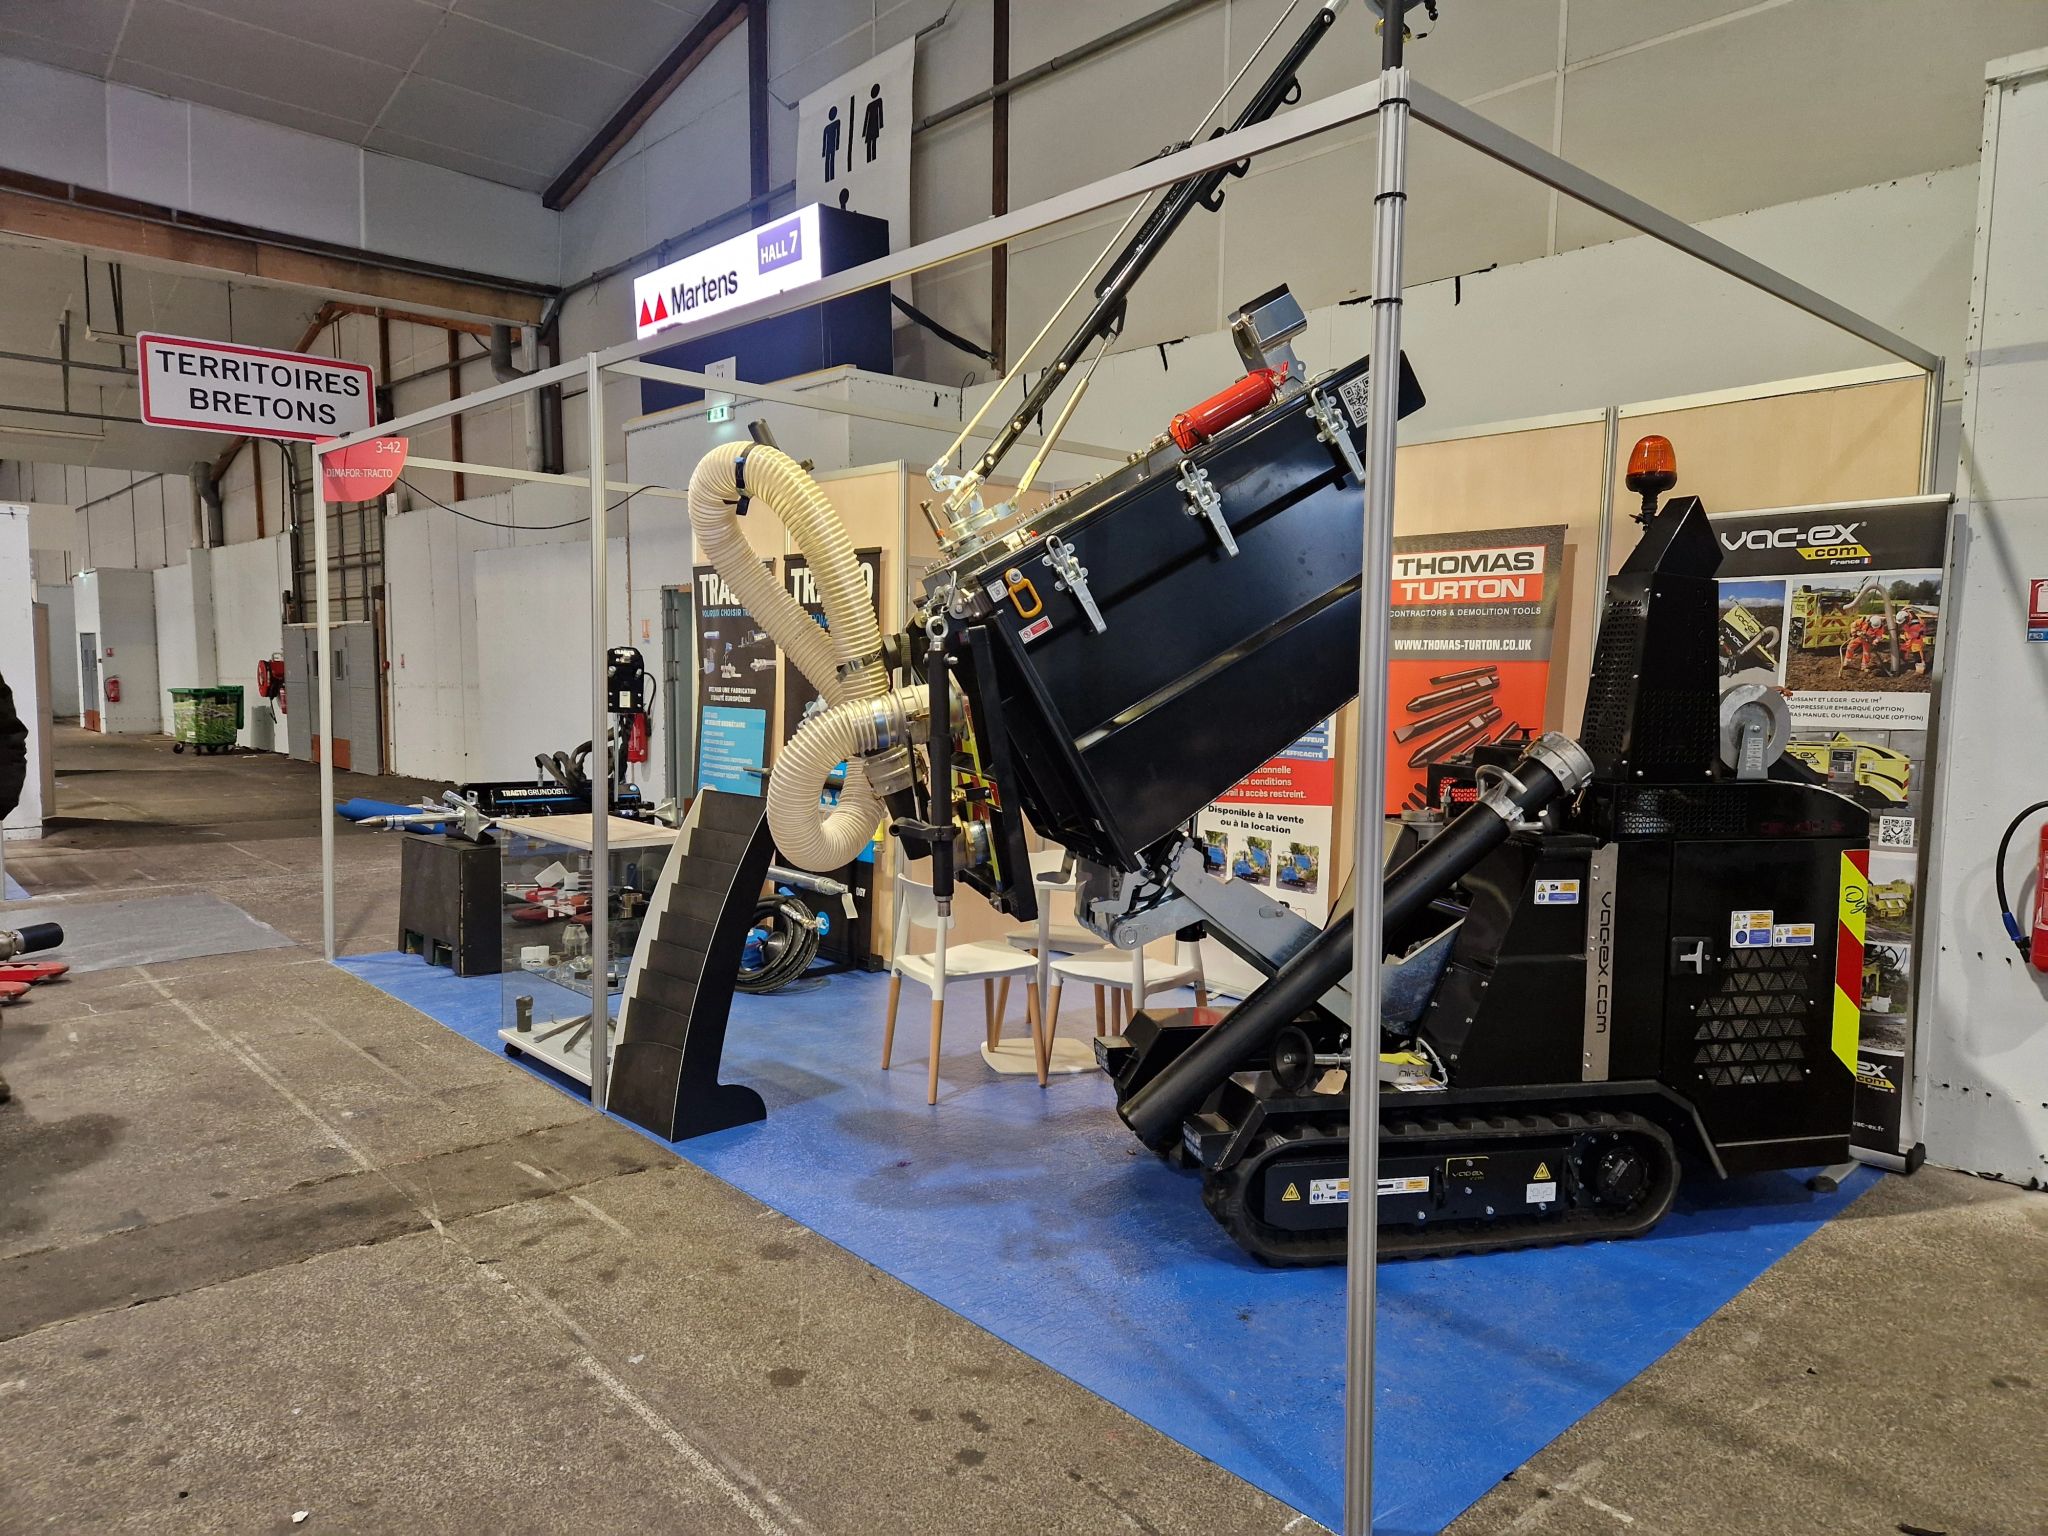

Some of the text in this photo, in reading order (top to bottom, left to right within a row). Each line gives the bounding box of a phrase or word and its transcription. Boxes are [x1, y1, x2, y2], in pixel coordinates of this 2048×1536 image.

[761, 230, 798, 265] HALL 7
[671, 270, 738, 316] Martens
[155, 349, 361, 397] TERRITOIRES
[189, 387, 336, 425] BRETONS
[375, 441, 401, 454] 3-42
[326, 468, 393, 478] DIMAFOR-TRACTO
[1720, 522, 1860, 551] vac-ex
[1807, 547, 1858, 558] .com
[1398, 551, 1534, 577] THOMAS
[1400, 578, 1525, 601] TURTON
[720, 608, 742, 617] CHOISIR
[1457, 608, 1510, 617] DEMOLITION
[1513, 606, 1542, 616] TOOLS
[1394, 639, 1532, 651] WWW.THOMAS-TURTON.CO.UK
[1250, 777, 1292, 786] conditions
[501, 789, 528, 797] TRACTO
[1240, 789, 1245, 797] à
[1245, 789, 1268, 798] accès
[1269, 789, 1306, 799] restreint.
[1208, 805, 1305, 824] Disponible à la vente
[1233, 818, 1239, 827] à
[1240, 820, 1249, 829] la
[1251, 821, 1291, 834] location
[1596, 891, 1611, 1034] vac-ex.com
